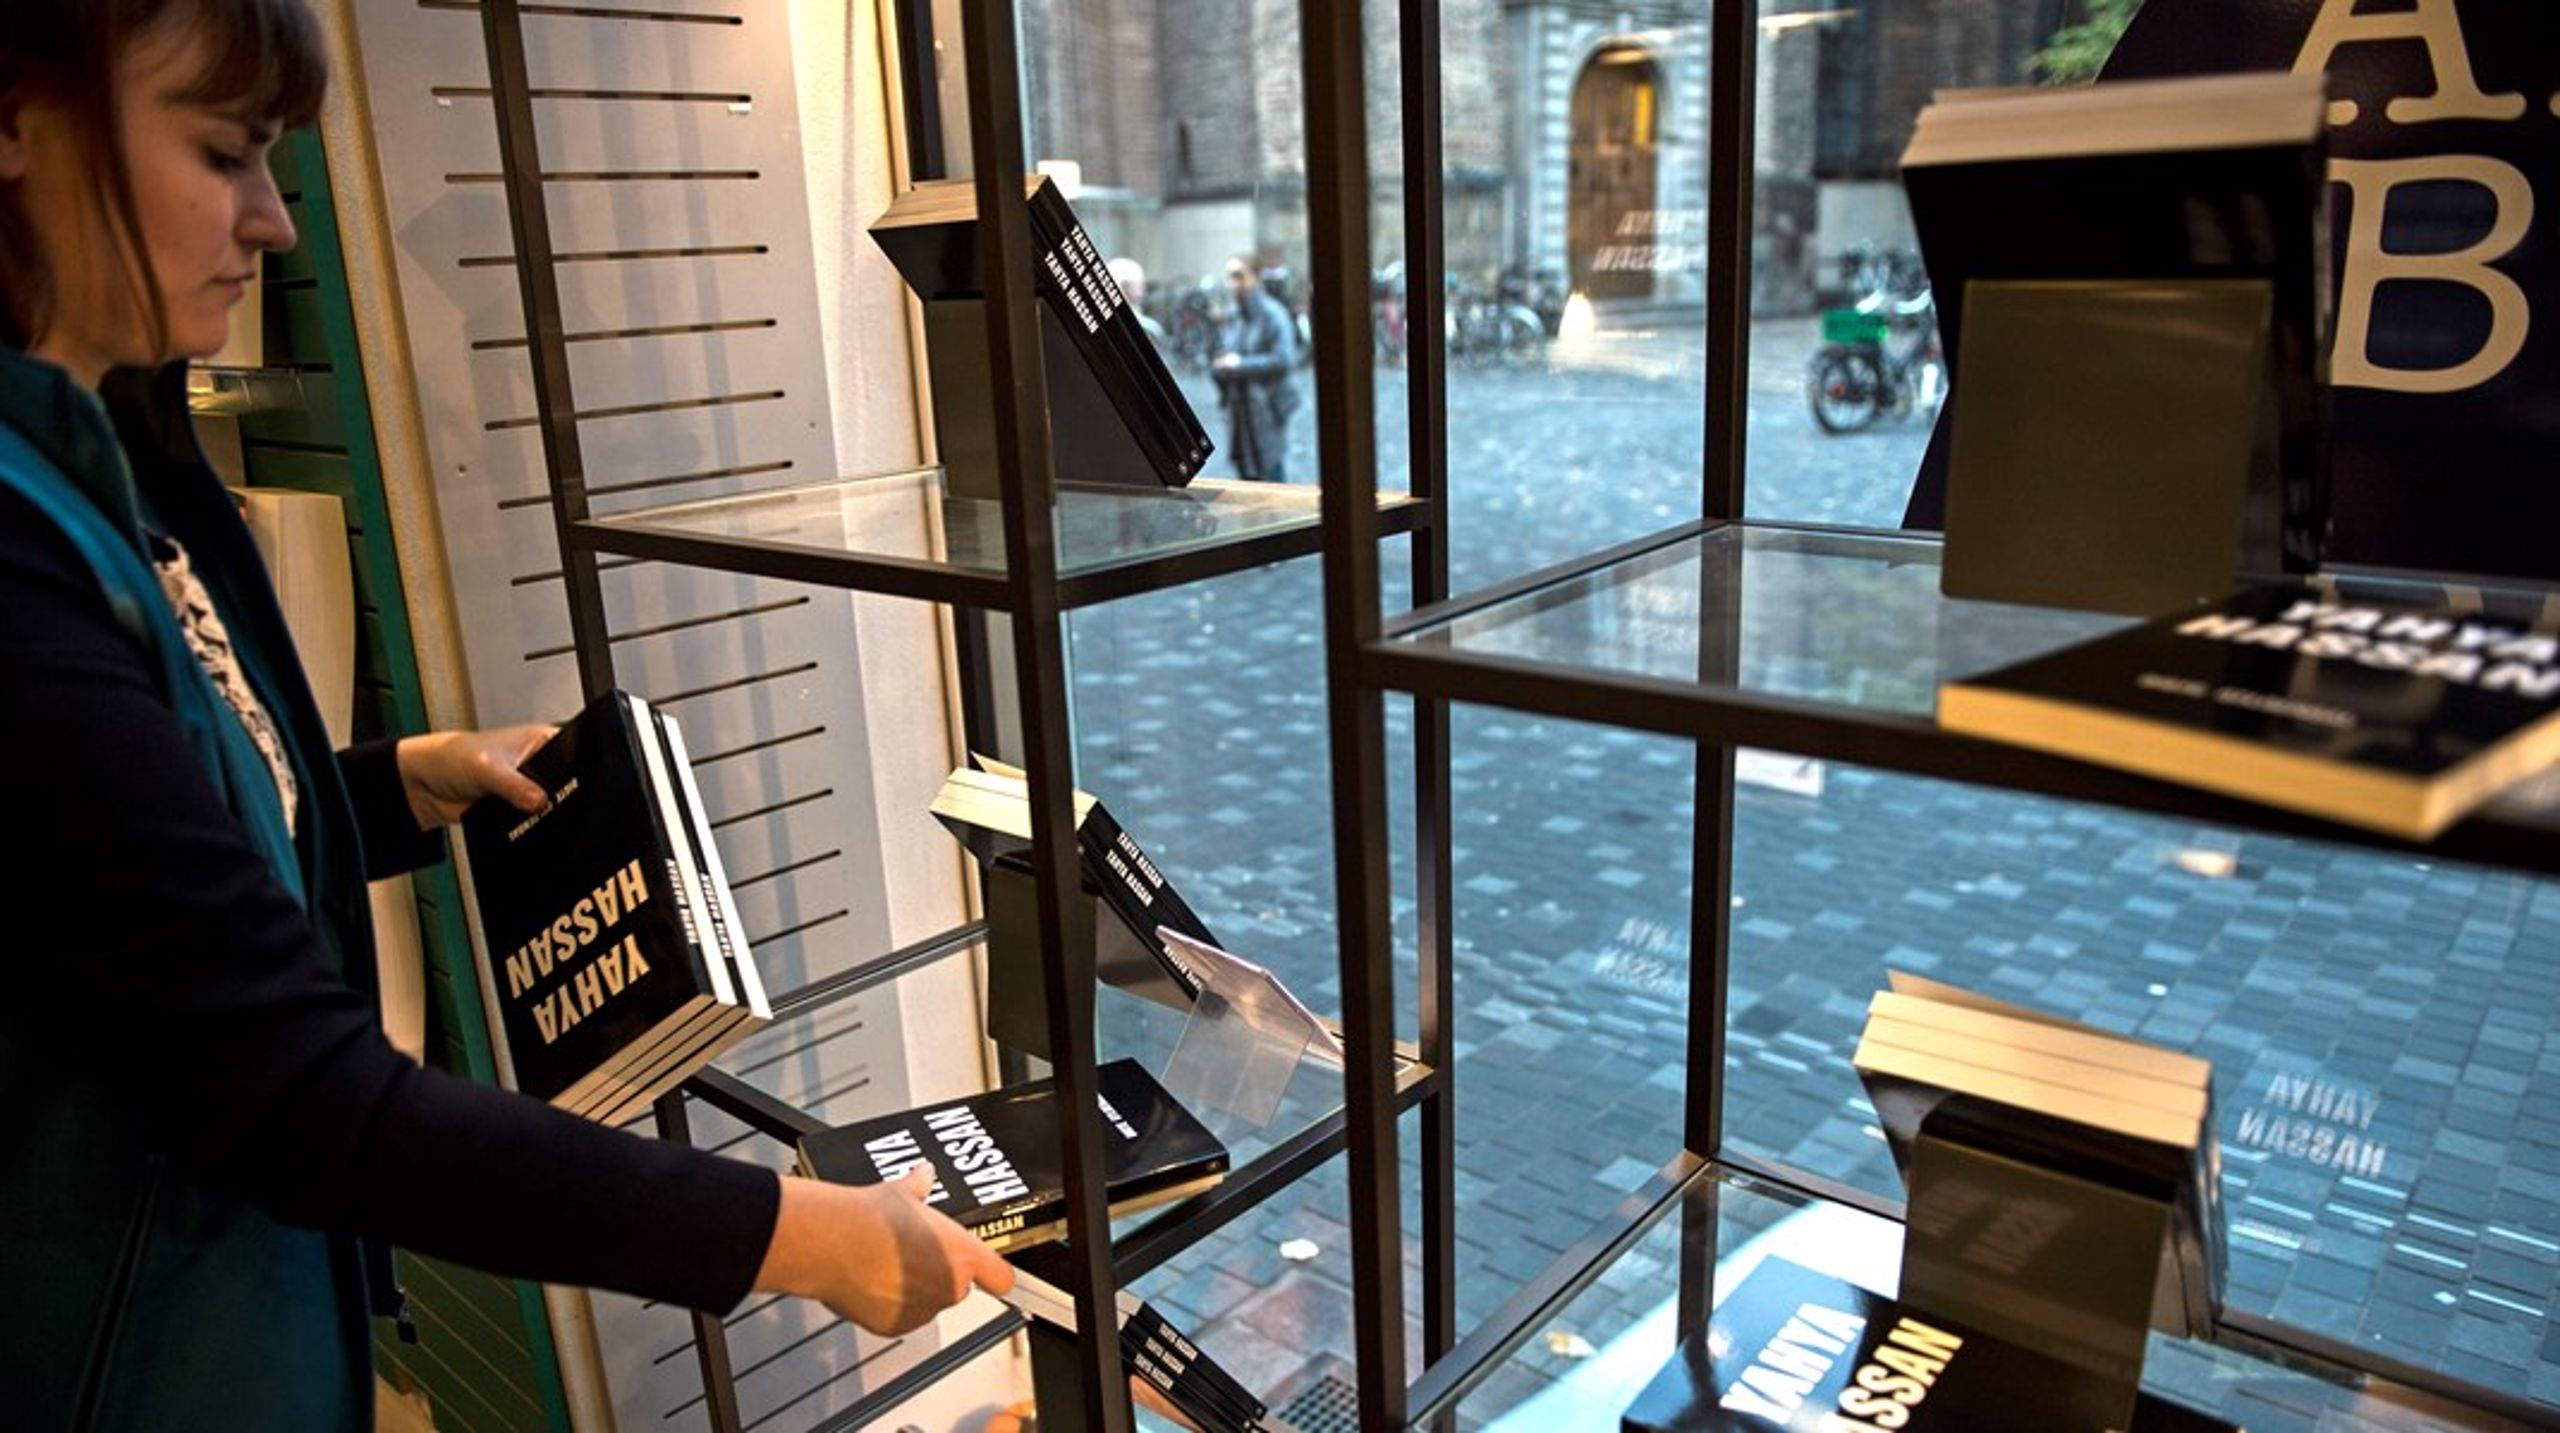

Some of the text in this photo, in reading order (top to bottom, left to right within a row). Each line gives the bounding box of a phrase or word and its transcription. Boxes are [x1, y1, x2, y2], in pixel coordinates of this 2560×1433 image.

[1044, 251, 1099, 334] YAHYA HASSAN
[1060, 237, 1113, 321] YAHYA HASSAN
[1071, 225, 1122, 307] YAHYA HASSAN
[2327, 153, 2534, 393] B
[504, 858, 649, 999] HASSAN
[531, 932, 650, 1044] YAHYA
[923, 1105, 1030, 1206] HASSAN
[1719, 1302, 1867, 1425] YAHYA
